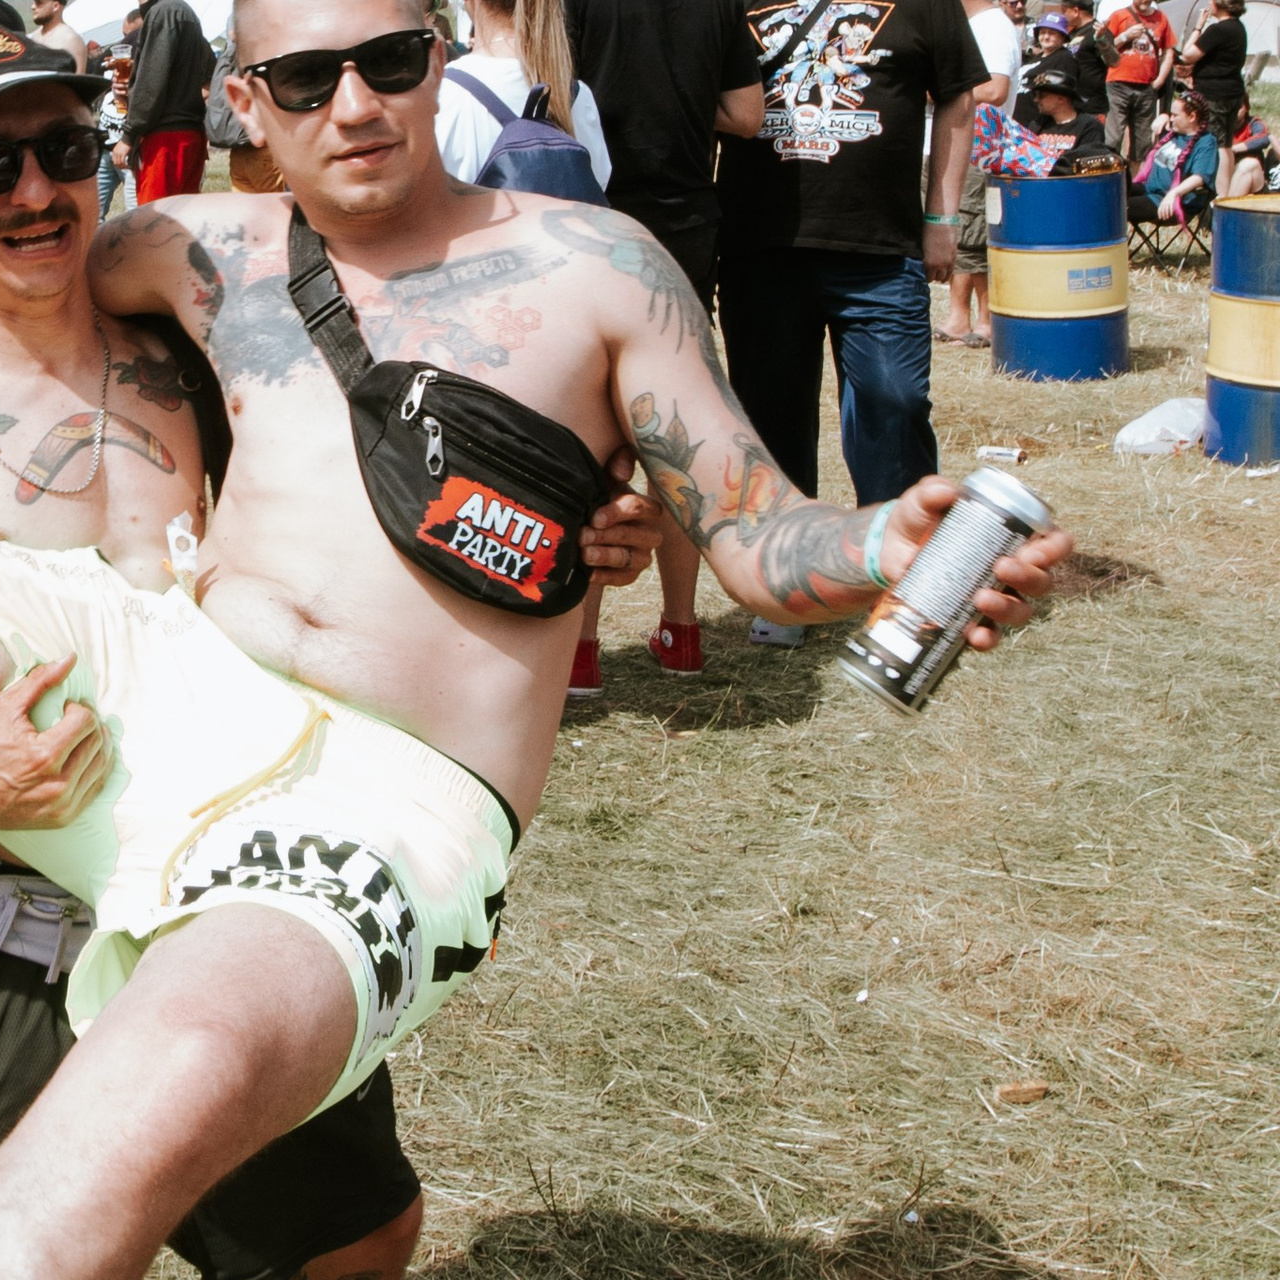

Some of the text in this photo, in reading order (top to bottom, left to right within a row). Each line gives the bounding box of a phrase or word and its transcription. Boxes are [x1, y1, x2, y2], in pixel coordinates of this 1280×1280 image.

[829, 119, 876, 133] MICE
[781, 140, 831, 152] MARS
[448, 522, 532, 580] PARTY
